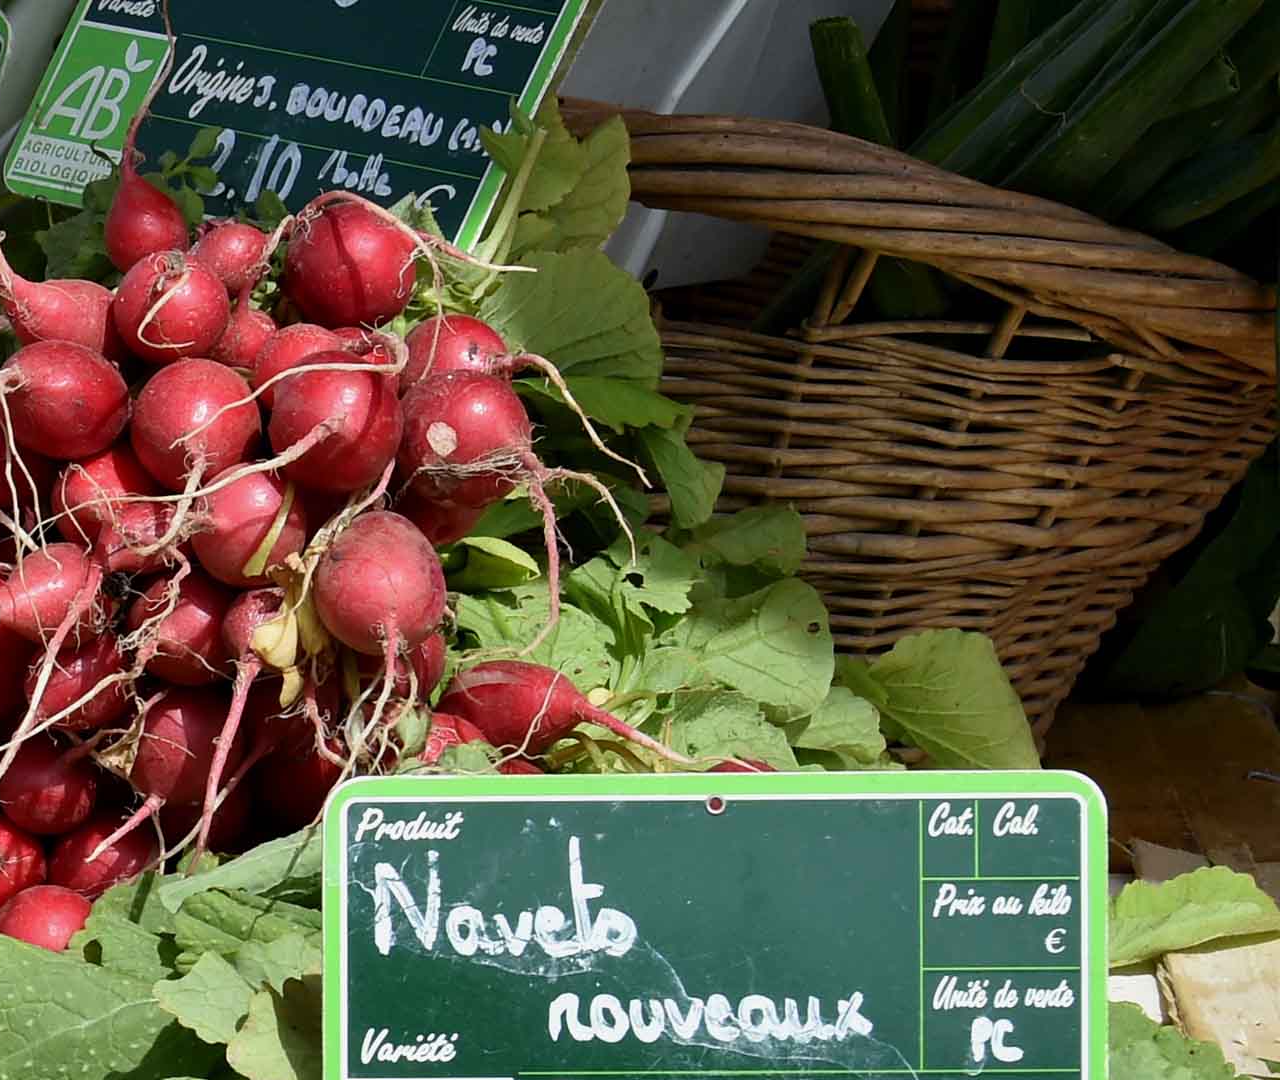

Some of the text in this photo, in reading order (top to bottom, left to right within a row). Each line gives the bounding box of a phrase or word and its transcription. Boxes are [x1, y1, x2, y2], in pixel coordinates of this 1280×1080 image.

[38, 65, 131, 140] AB
[168, 44, 255, 119] Origine
[285, 82, 444, 147] BOURDEAU
[355, 807, 464, 841] Produit
[927, 801, 975, 837] Cat.
[992, 801, 1040, 837] Cal.
[932, 883, 1073, 918] Prix au kilo
[1044, 928, 1067, 954] €
[932, 975, 1076, 1011] Unité de vente
[548, 991, 874, 1043] nouveaux
[360, 1028, 459, 1065] Variété
[970, 1016, 1025, 1063] PC
